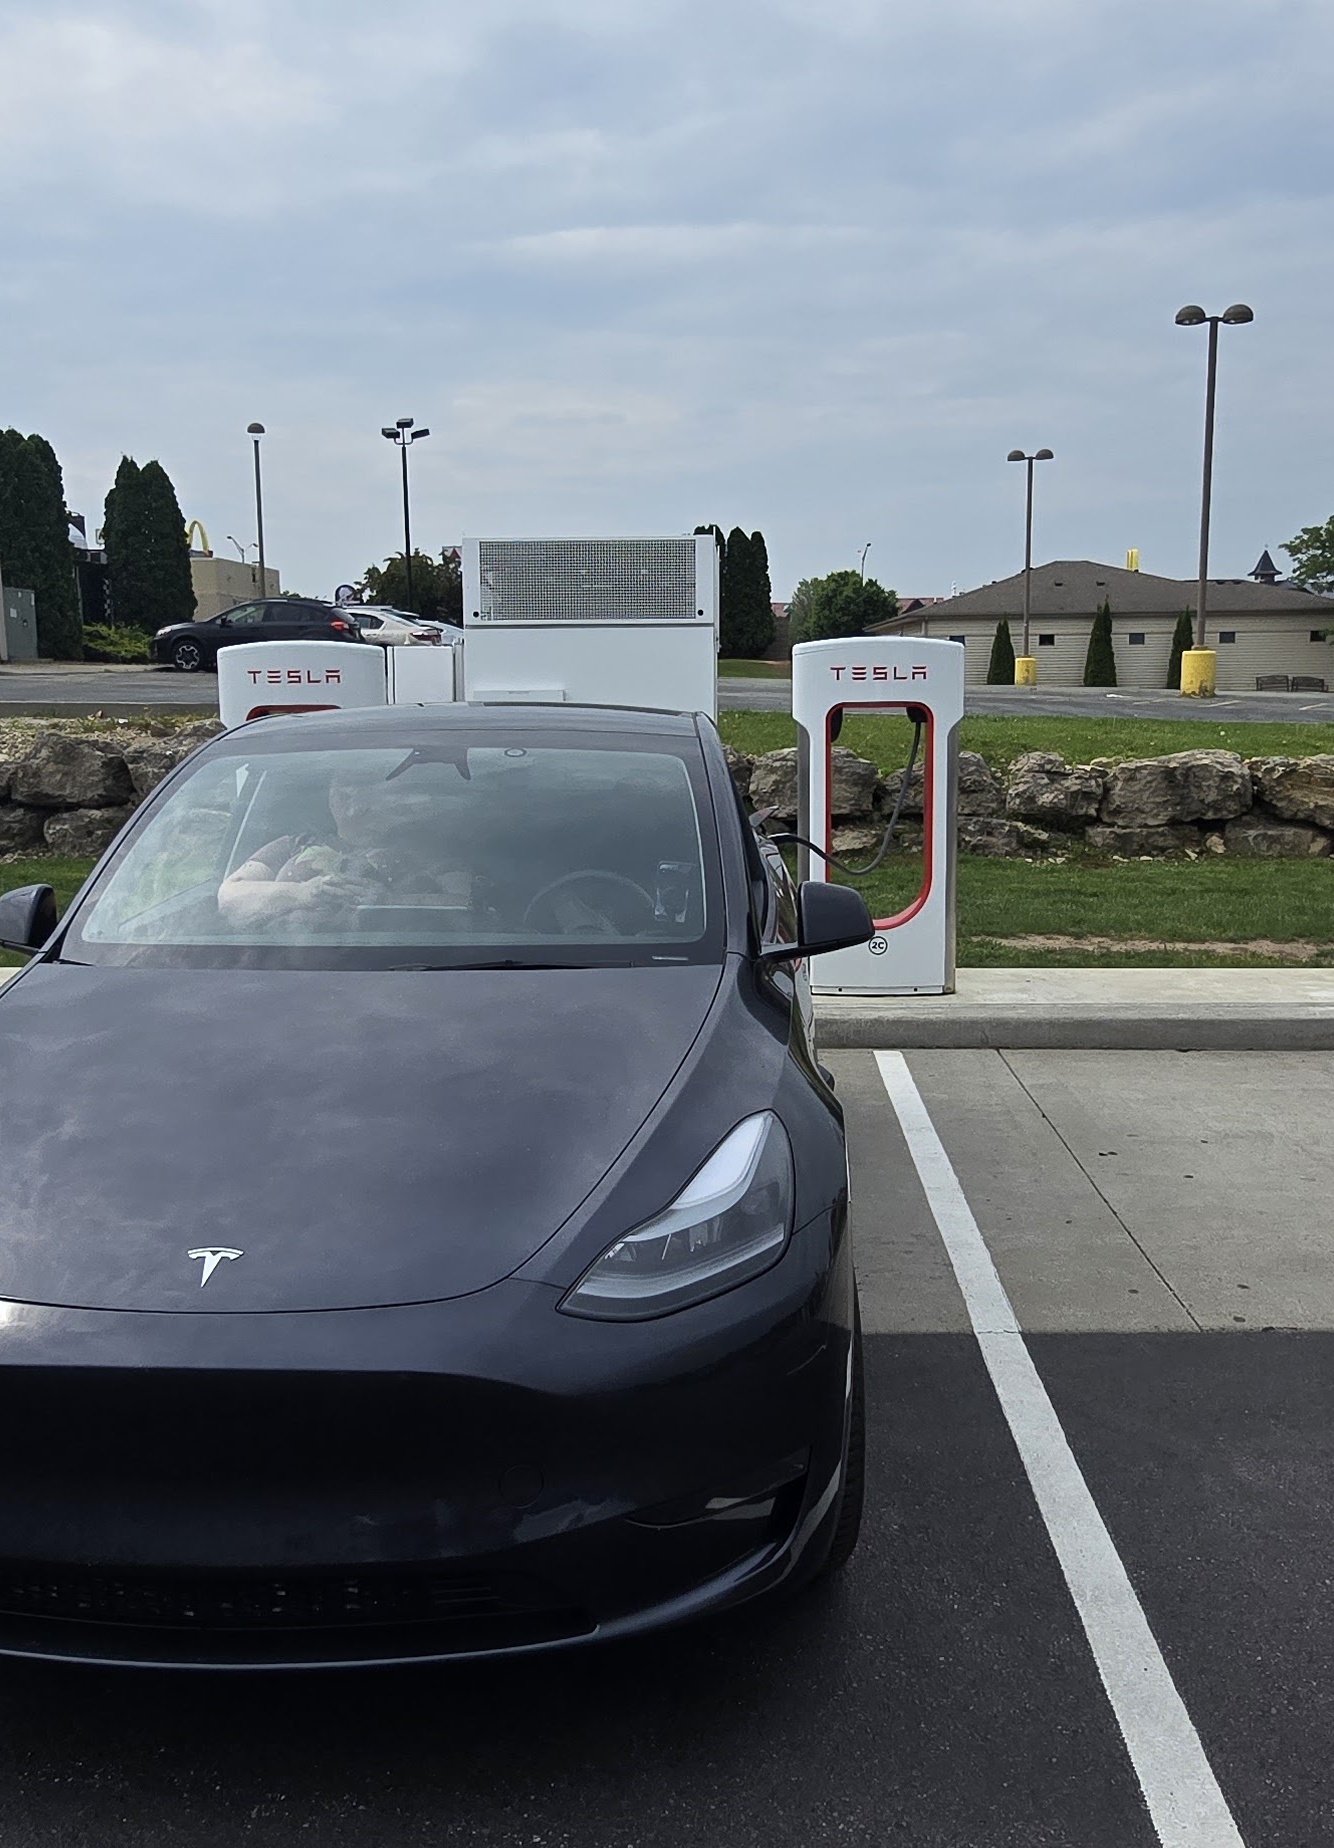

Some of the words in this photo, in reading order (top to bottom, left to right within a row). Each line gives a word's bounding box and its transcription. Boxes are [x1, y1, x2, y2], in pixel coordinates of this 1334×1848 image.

[247, 669, 341, 684] TESLA
[830, 666, 927, 680] TESLA
[871, 941, 885, 950] 2C
